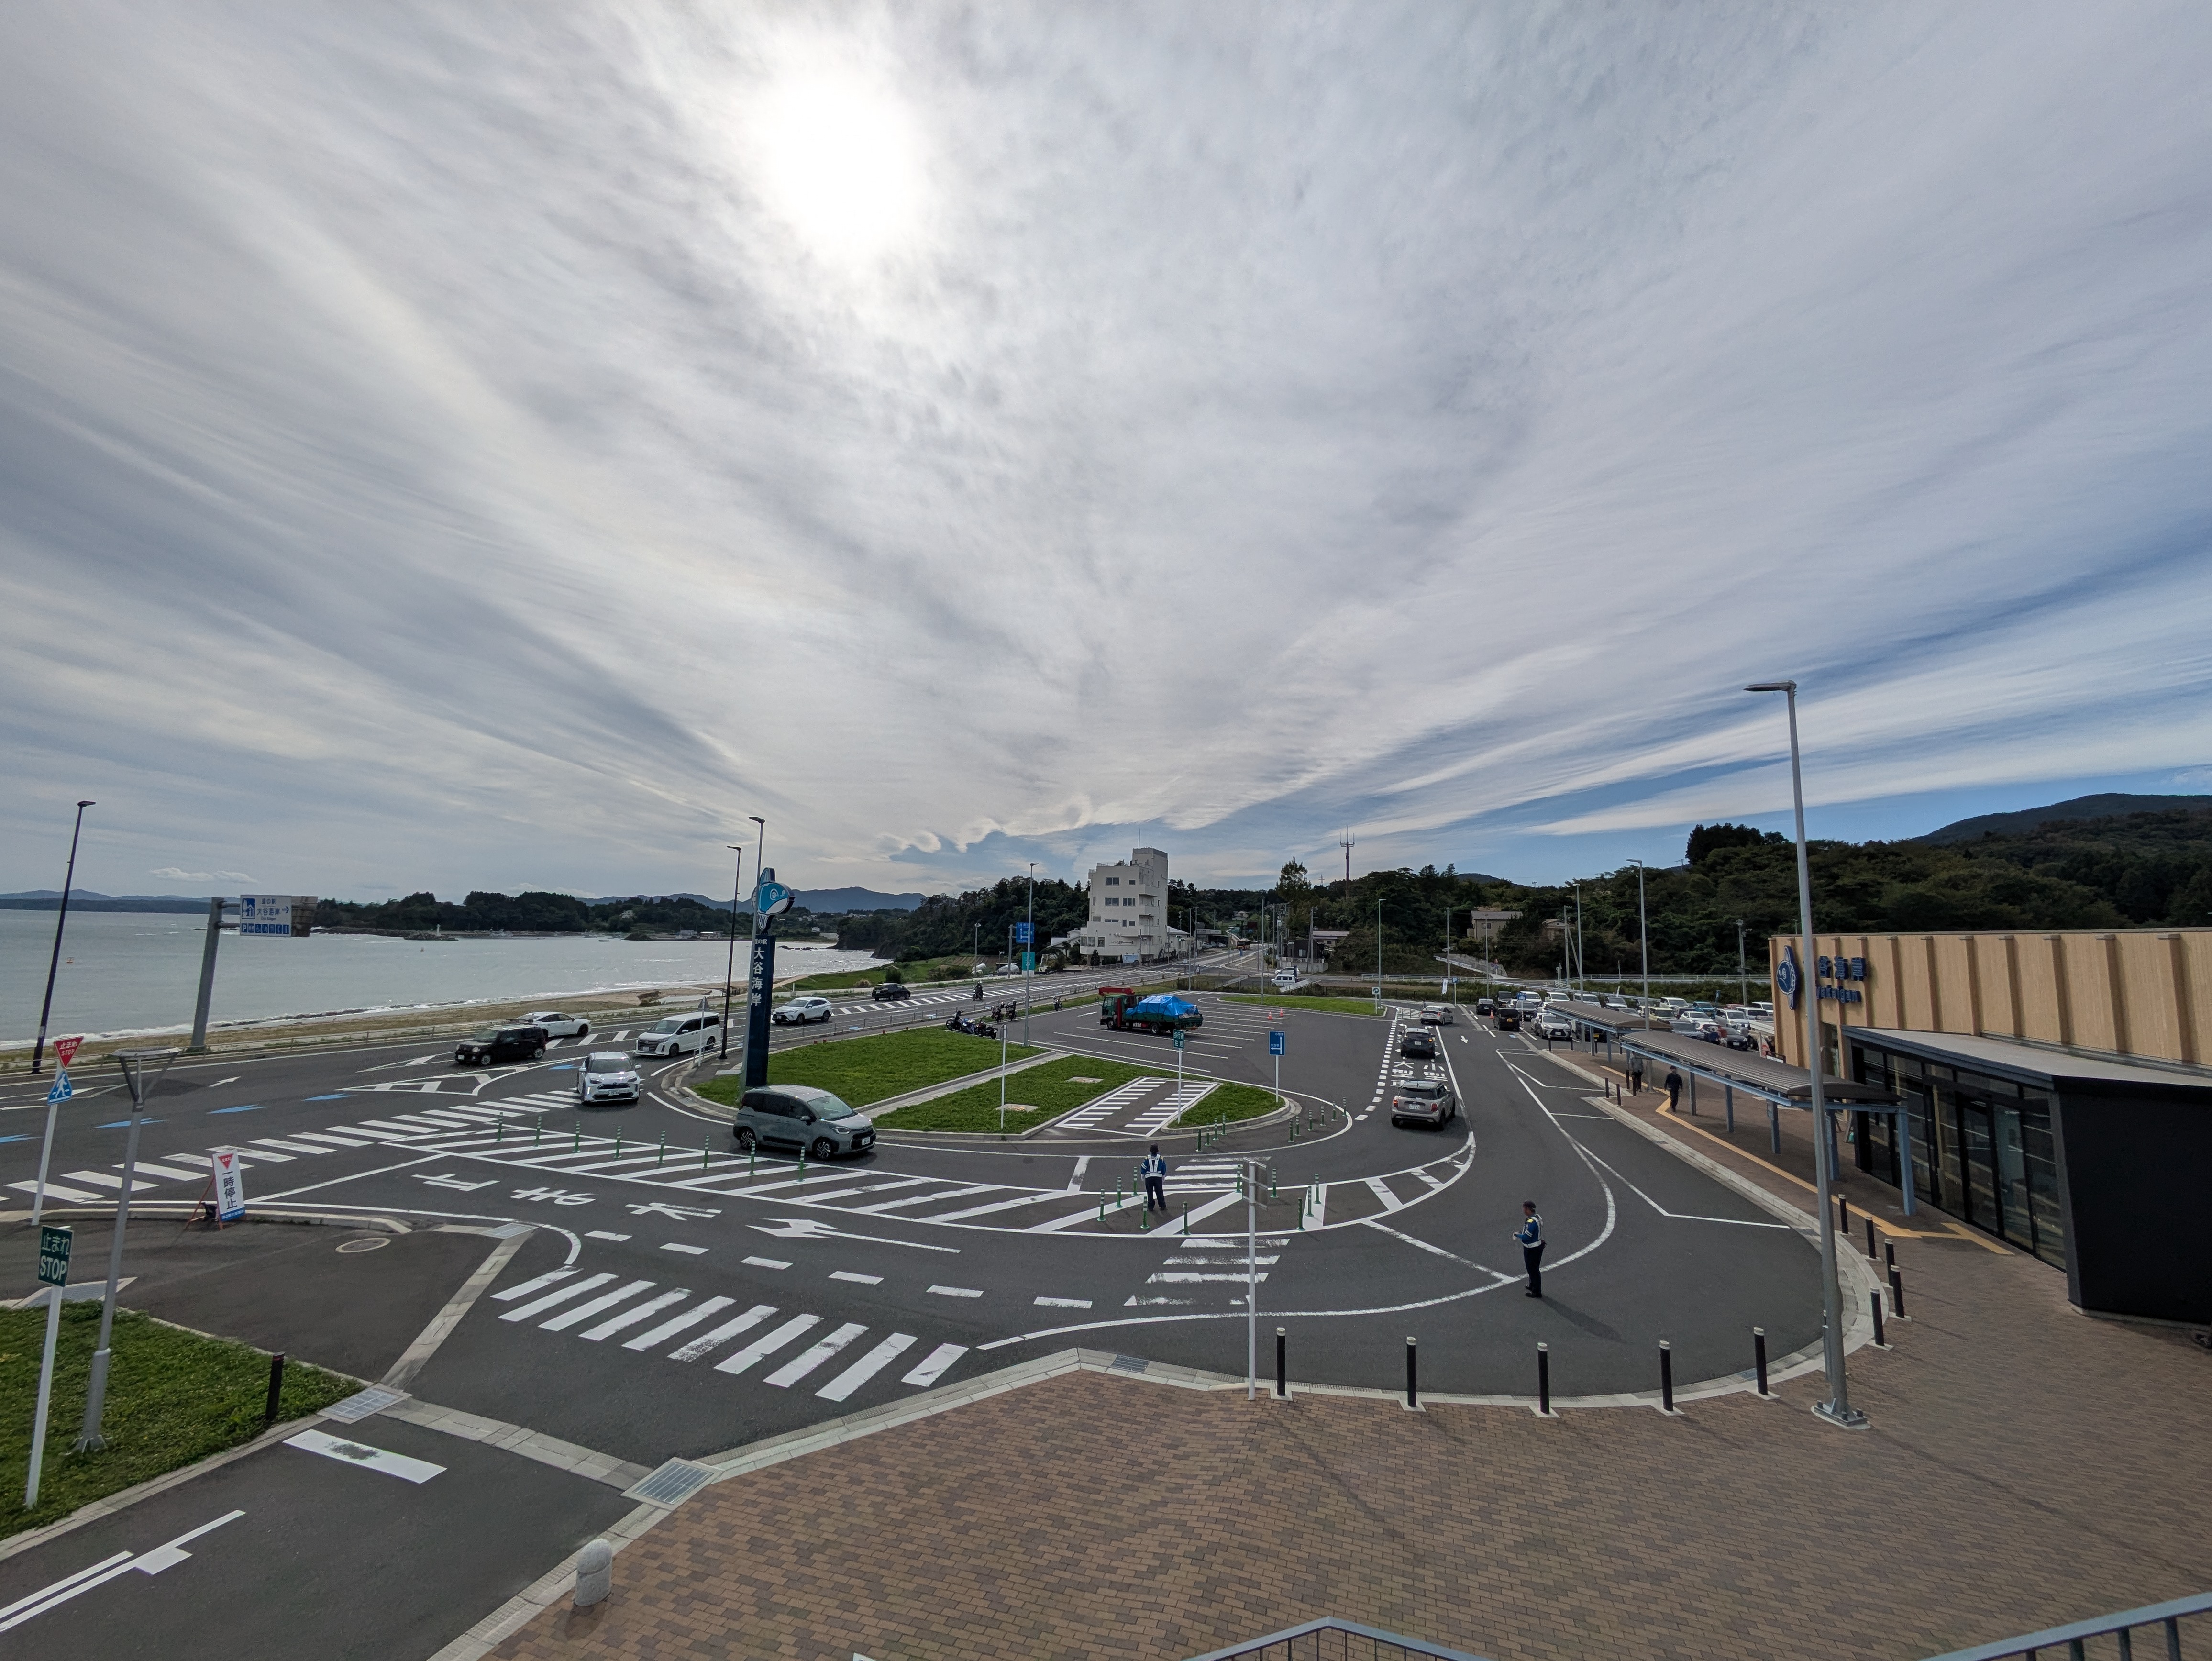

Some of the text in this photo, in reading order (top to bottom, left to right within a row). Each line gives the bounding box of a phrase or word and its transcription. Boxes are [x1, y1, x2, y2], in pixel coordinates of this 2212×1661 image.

[751, 947, 765, 1006] 大谷海岸
[1810, 956, 1864, 981] 谷海岸
[59, 1041, 77, 1050] 止まれ
[222, 1171, 237, 1210] 一時停止
[42, 1233, 69, 1255] 止まれ
[40, 1255, 66, 1281] STOP
